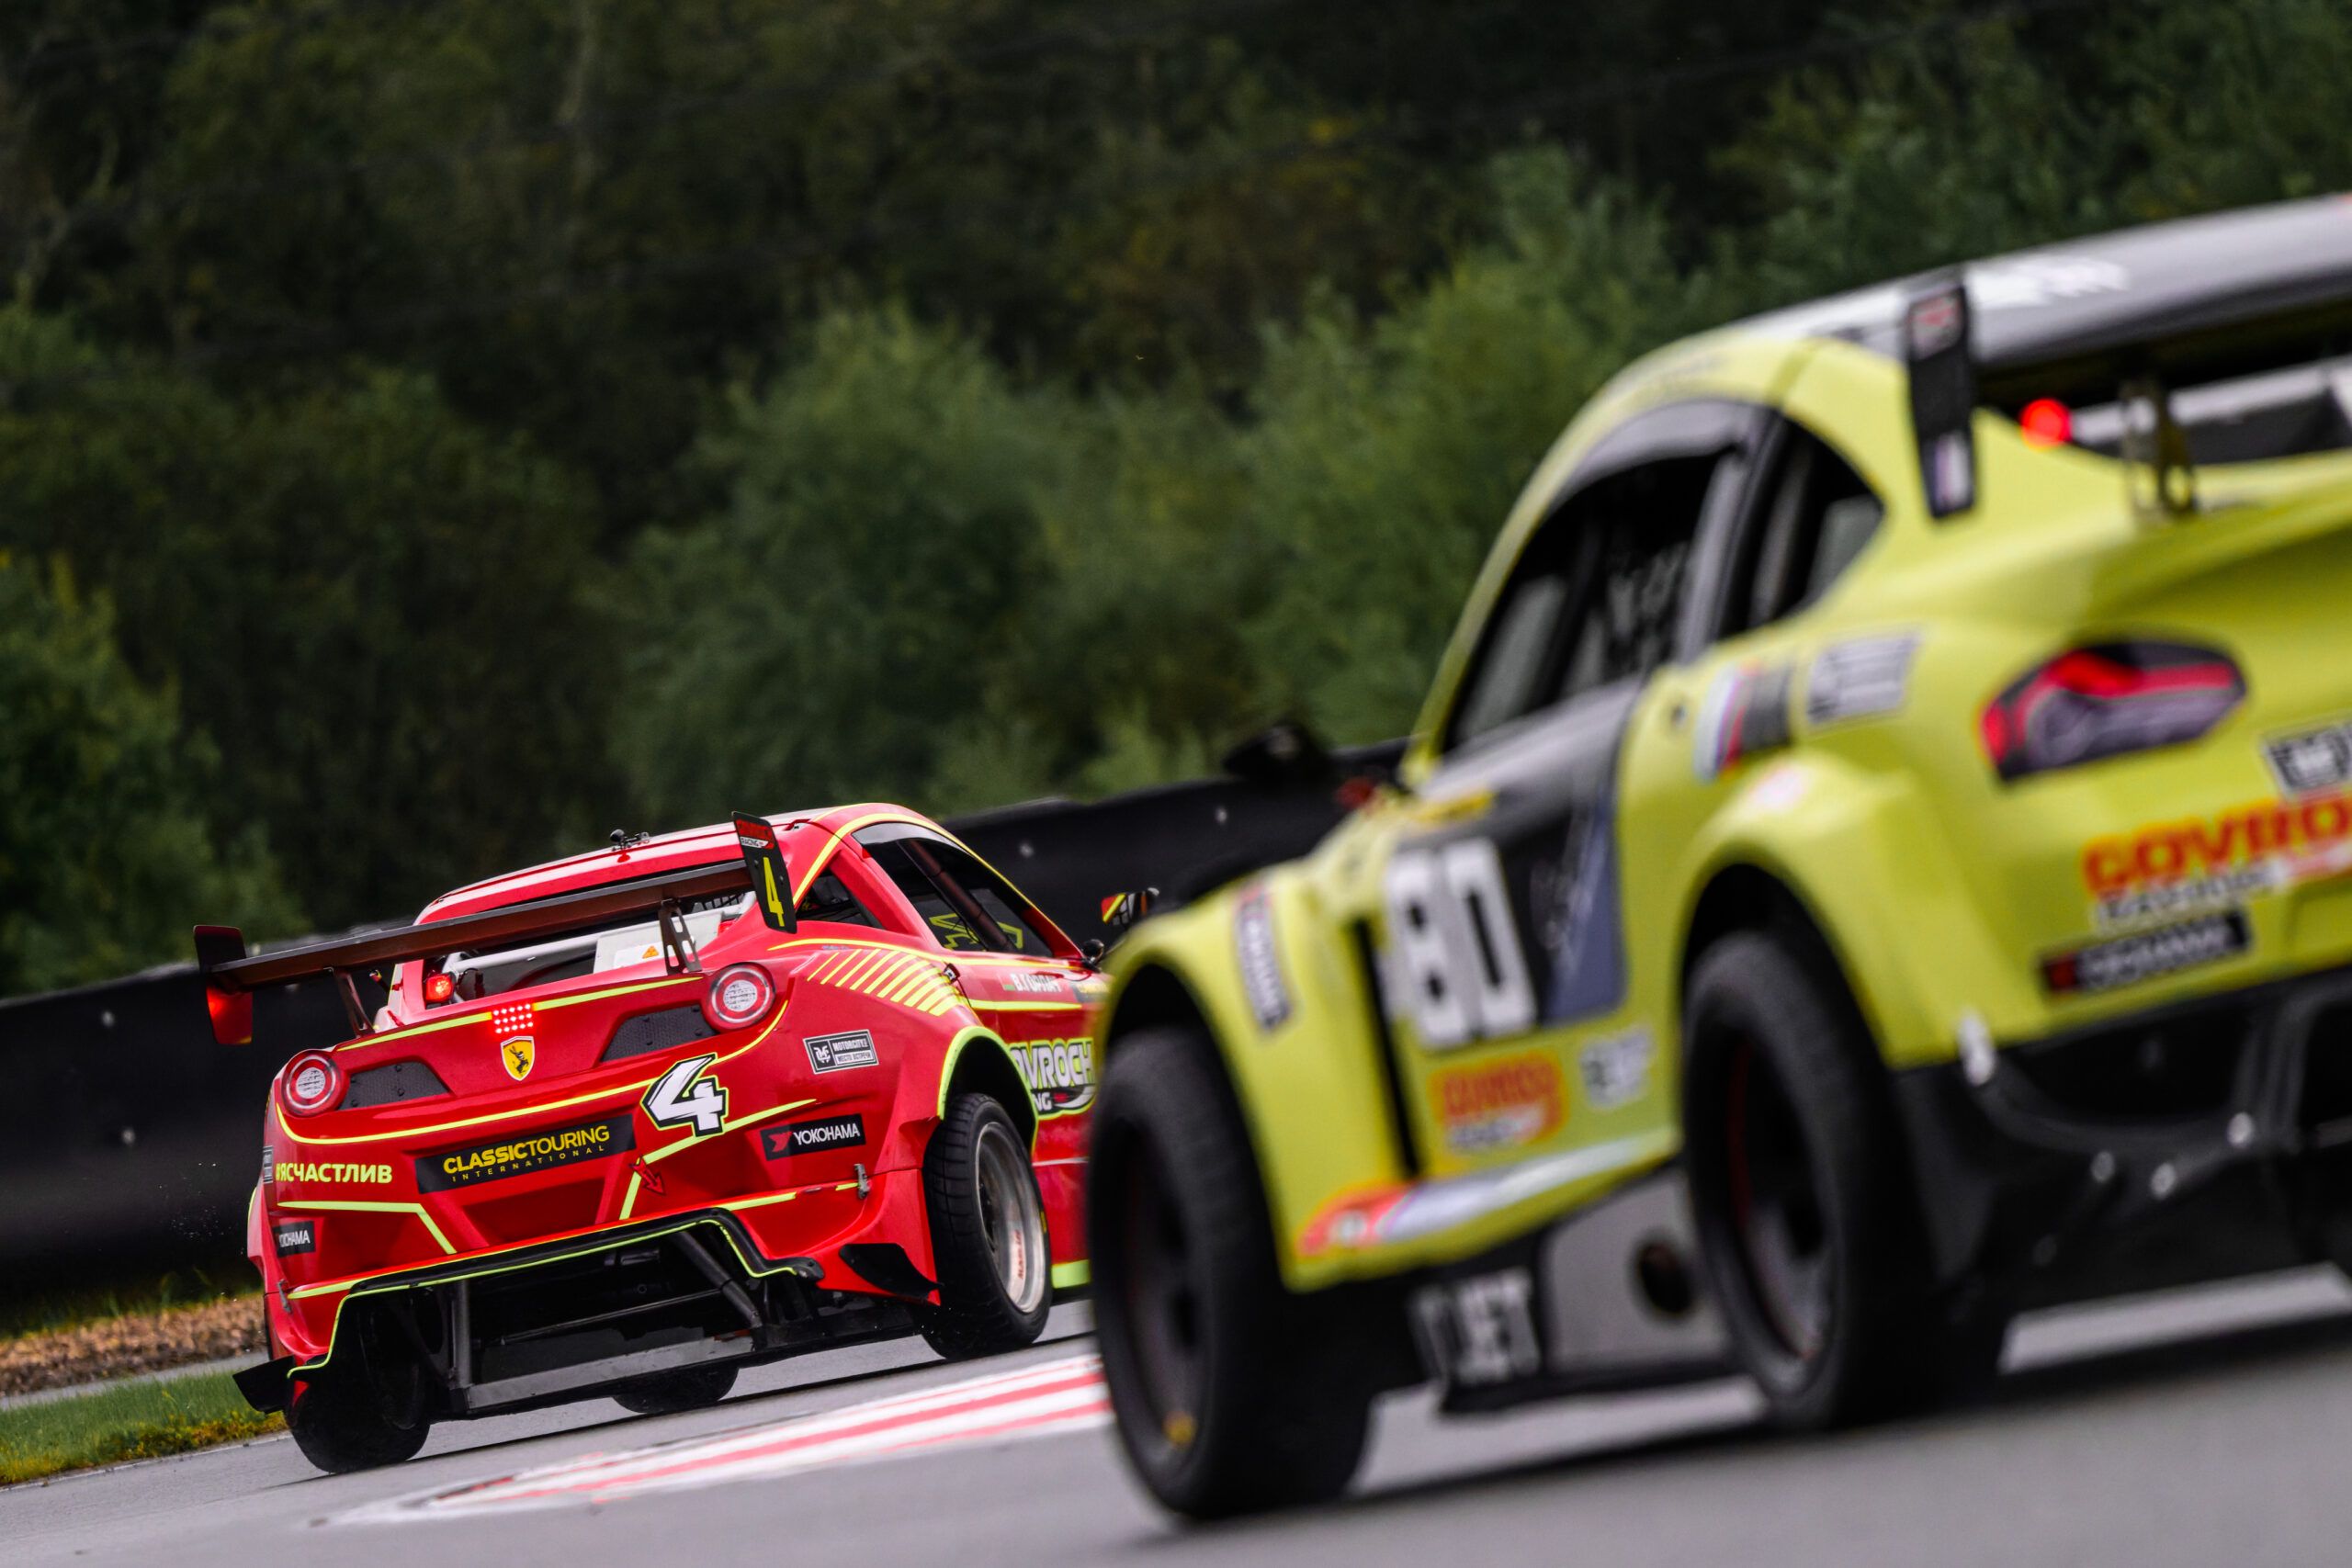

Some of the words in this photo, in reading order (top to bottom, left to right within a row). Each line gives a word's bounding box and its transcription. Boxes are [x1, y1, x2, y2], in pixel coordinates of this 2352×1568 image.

[763, 856, 785, 928] 4
[1383, 840, 1536, 1047] 80
[641, 1053, 728, 1138] 4
[443, 1125, 611, 1175] CLASSICTOURING
[451, 1145, 605, 1183] INTERNATIONAL
[793, 1122, 861, 1145] YOKOHAMA
